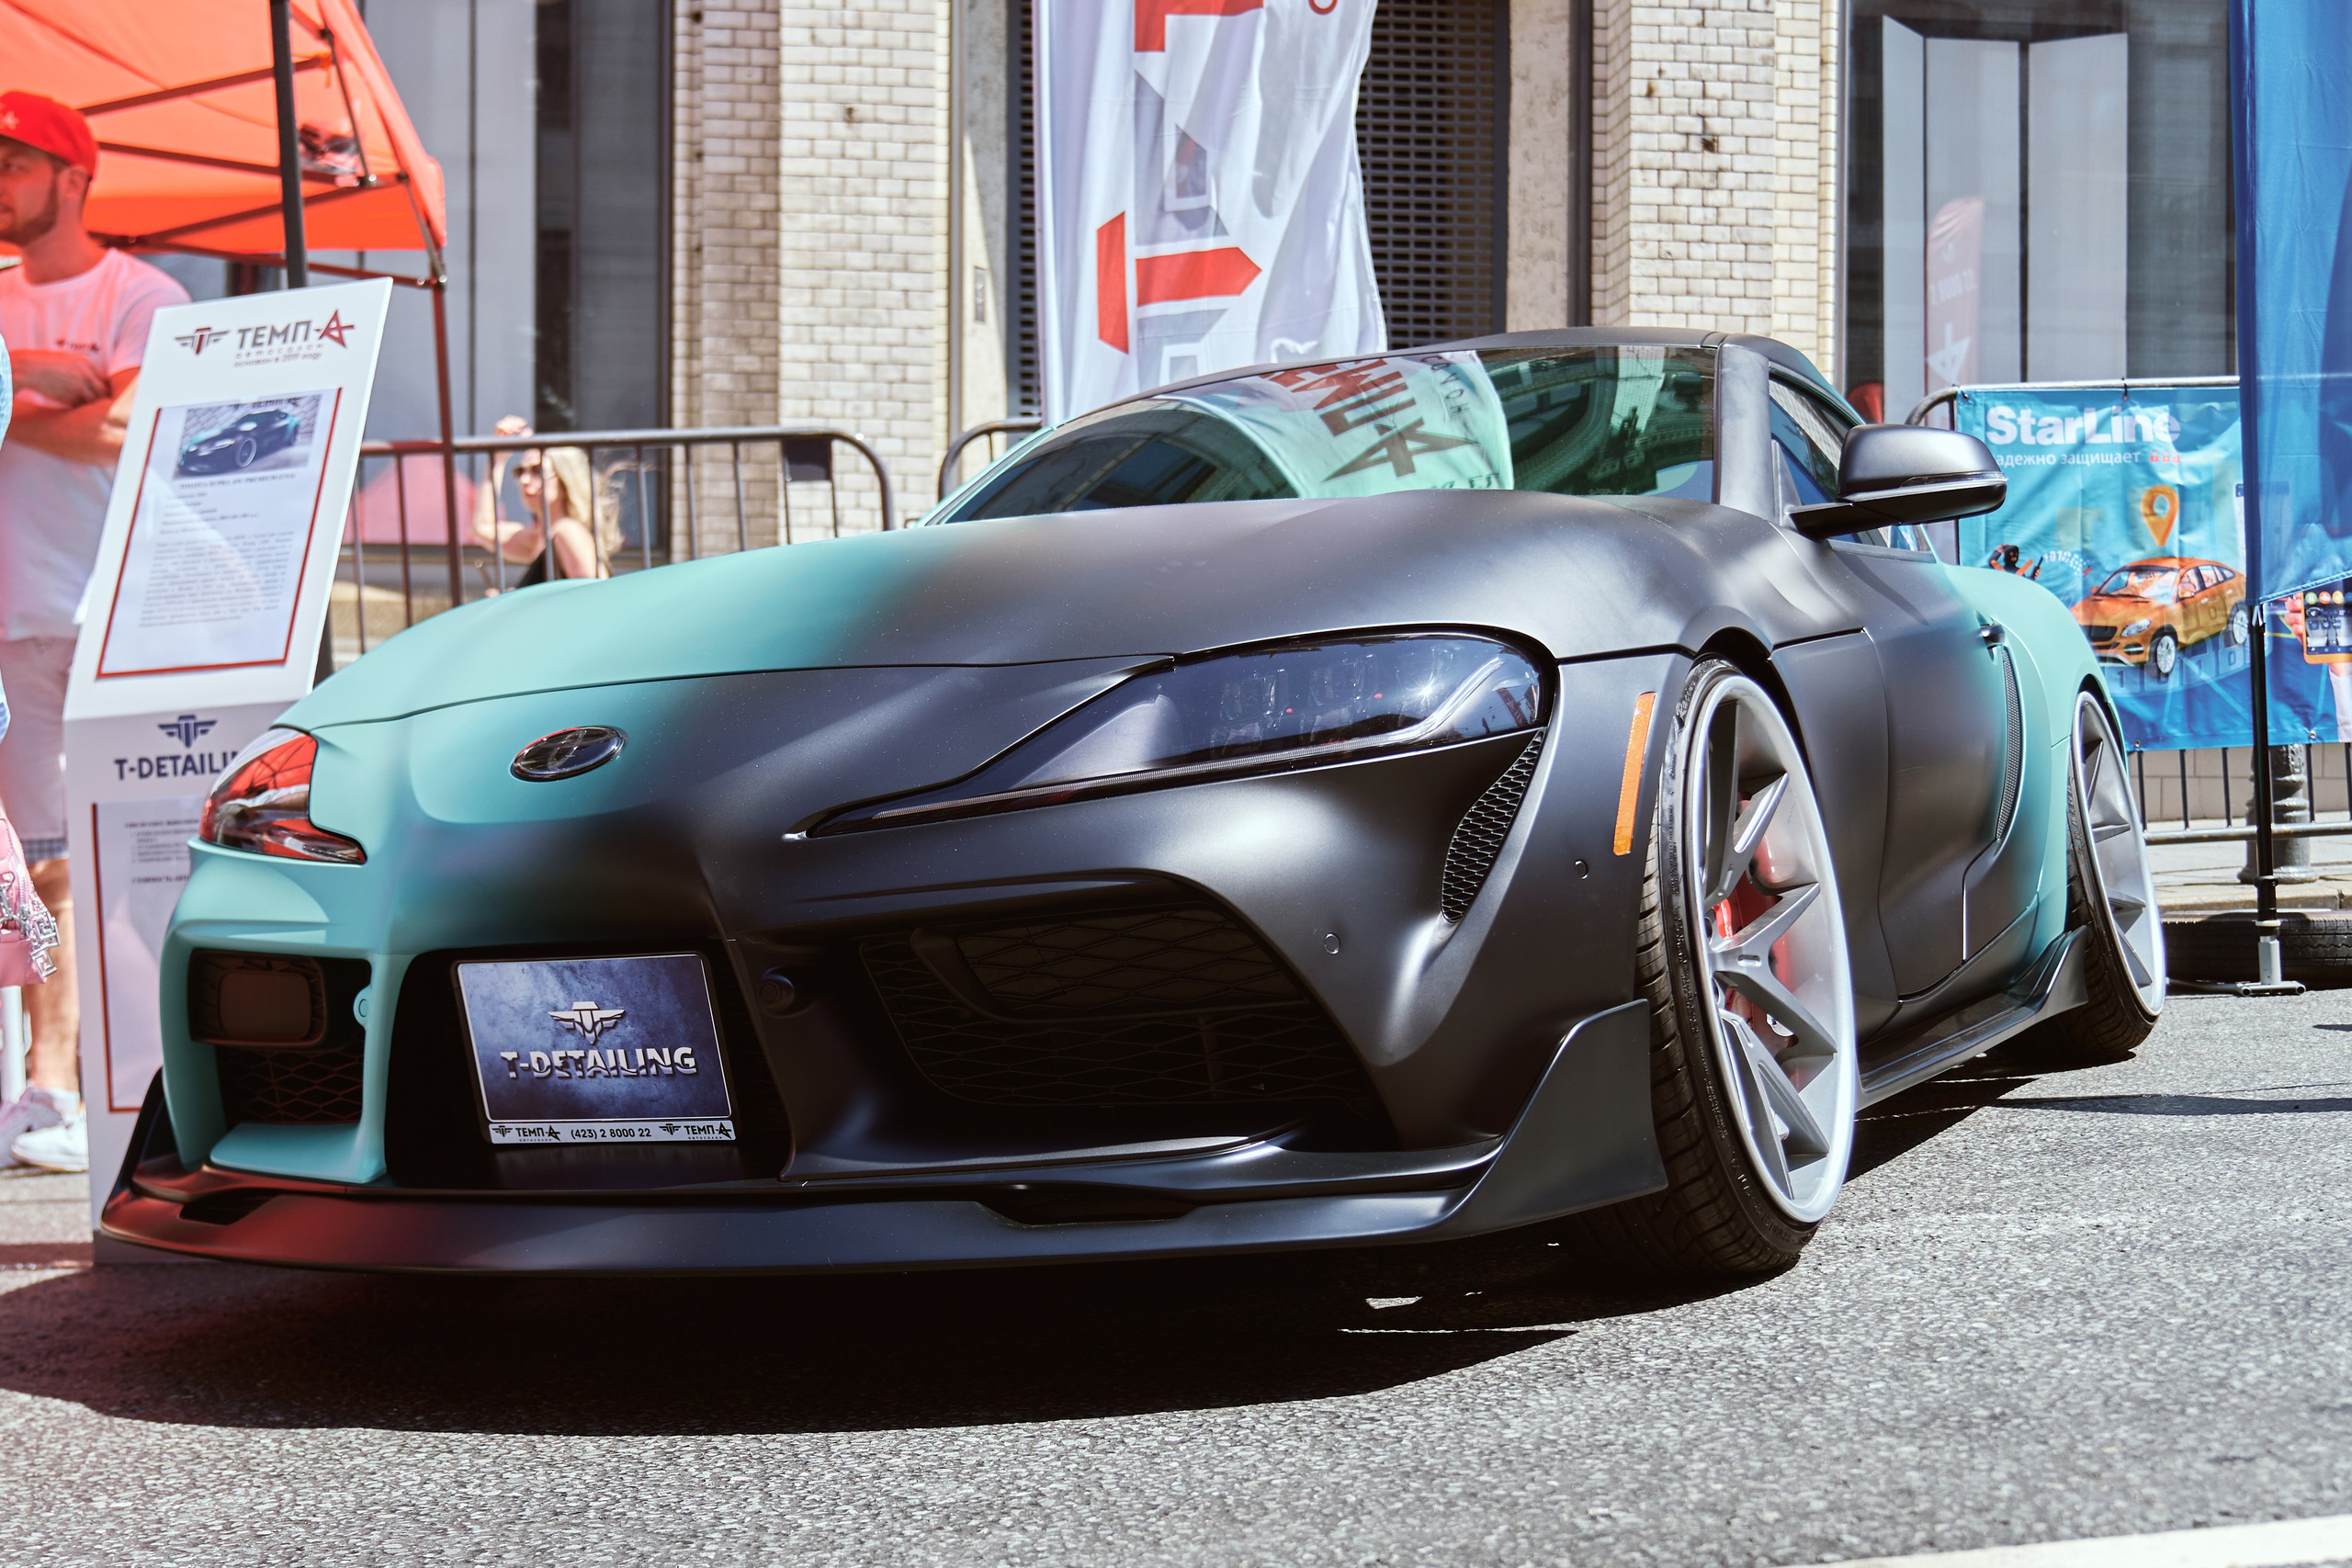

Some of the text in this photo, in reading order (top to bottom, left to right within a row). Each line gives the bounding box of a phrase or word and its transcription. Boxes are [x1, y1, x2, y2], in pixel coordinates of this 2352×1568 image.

[1985, 405, 2181, 446] StarLine
[1996, 451, 2141, 468] адежно защищает
[114, 751, 238, 781] T-DETAILI
[500, 1046, 697, 1078] T-DETAILING
[571, 1128, 651, 1140] (423) 2 8000 22
